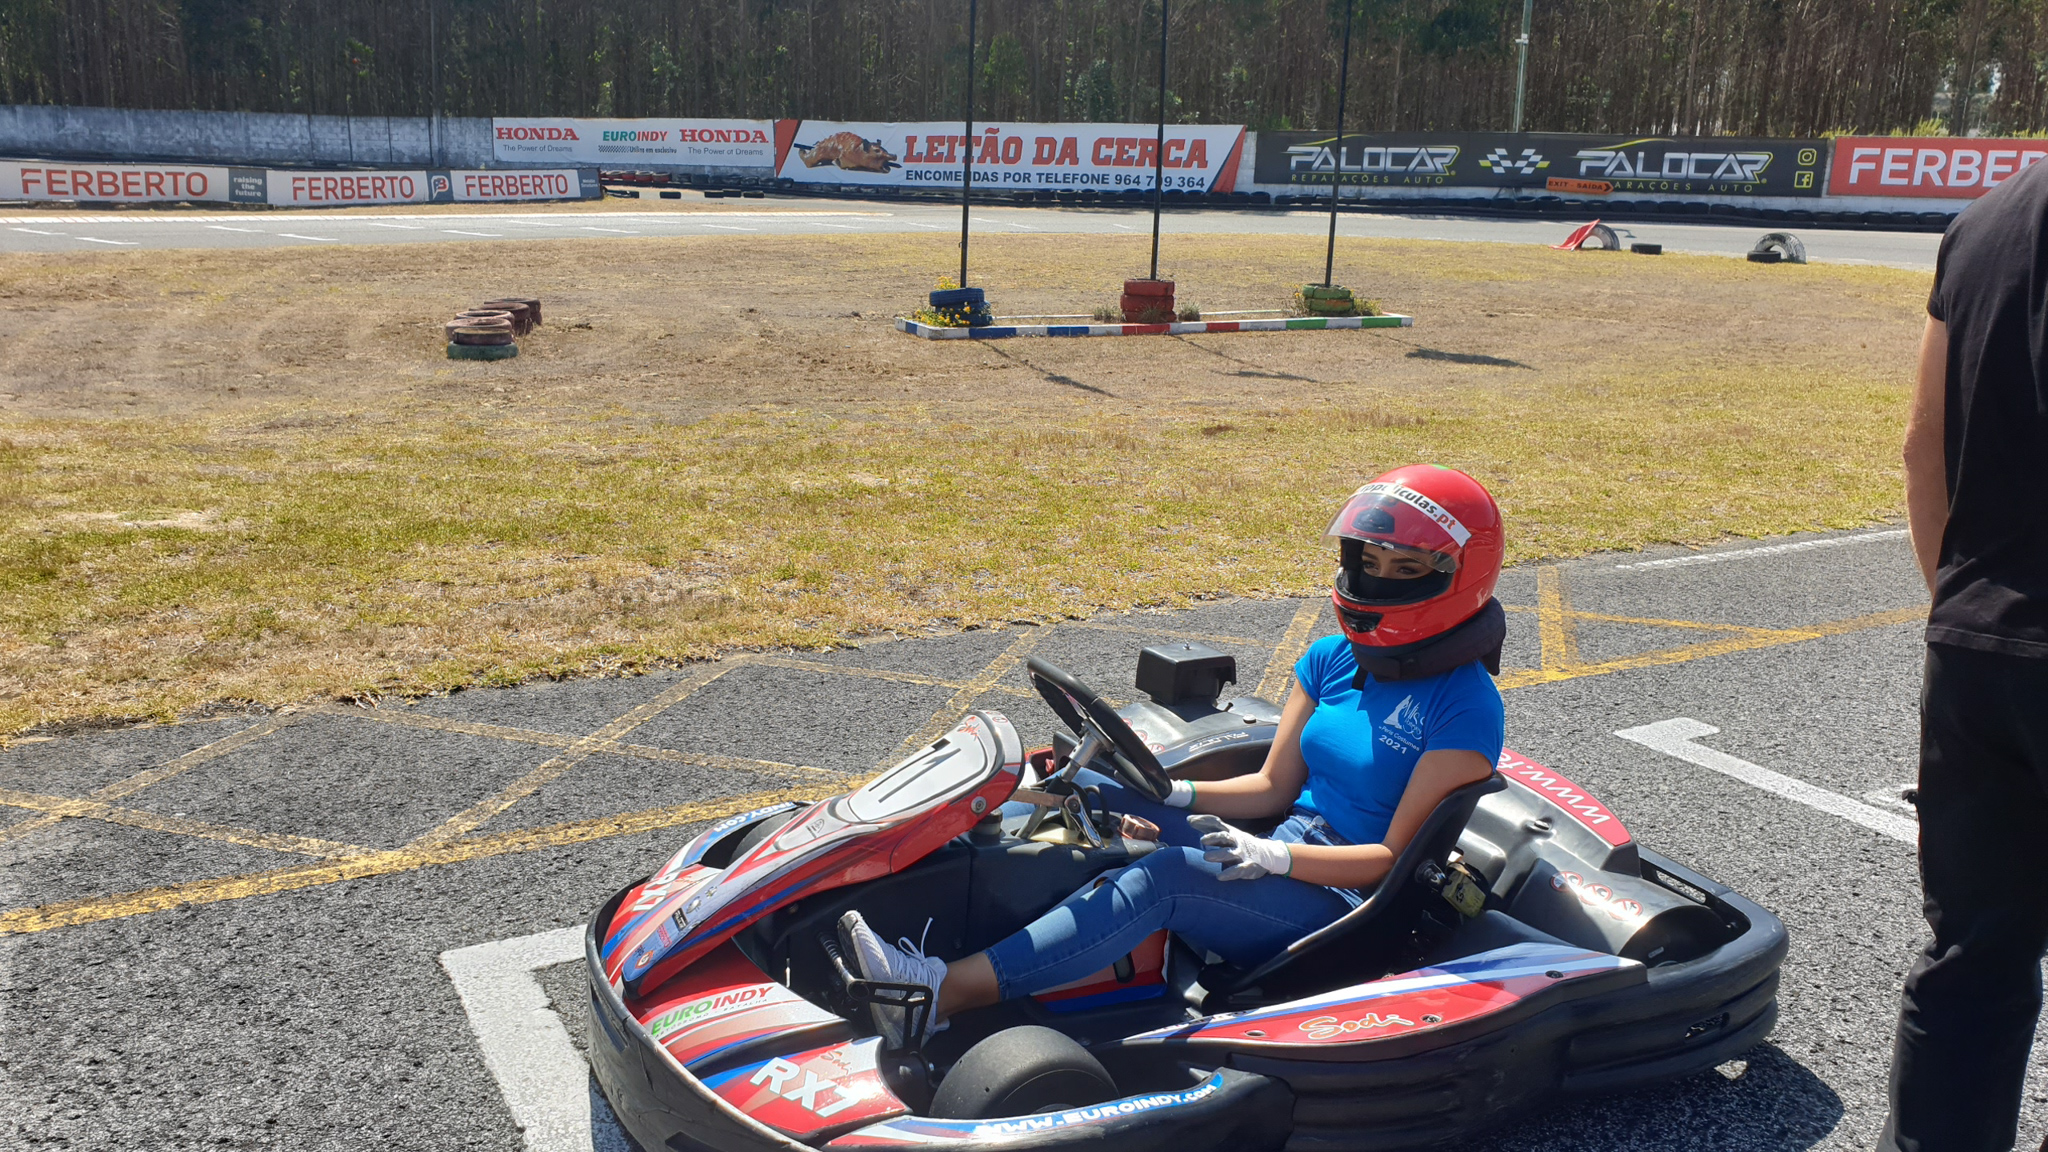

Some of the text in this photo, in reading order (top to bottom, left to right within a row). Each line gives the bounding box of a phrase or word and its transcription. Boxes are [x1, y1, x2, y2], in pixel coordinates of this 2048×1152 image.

[496, 127, 579, 140] HONDA
[602, 131, 668, 141] EUROINDY
[679, 129, 769, 143] HONDA
[735, 148, 763, 156] Dreams
[903, 127, 1208, 168] LEITÃO DA CERCA
[1286, 145, 1460, 173] PALOCAR
[1574, 150, 1770, 181] PALOCAR
[21, 168, 208, 197] FERBERTO
[233, 176, 263, 186] raising
[292, 175, 415, 201] FERBERTO
[464, 174, 569, 197] FERBERTO
[1003, 172, 1031, 183] POR
[1036, 172, 1110, 184] TELEFONE
[1114, 174, 1141, 186] 964
[1146, 175, 1172, 187] 79
[1177, 176, 1205, 188] 364
[1404, 176, 1443, 184] AUTO
[1548, 180, 1568, 188] EXIT
[235, 189, 262, 197] future
[1708, 184, 1753, 193] AUTO
[1379, 735, 1407, 754] 2021
[651, 986, 774, 1036] EUROINDY
[973, 1083, 1217, 1134] WWW.EUROINDY.COM
